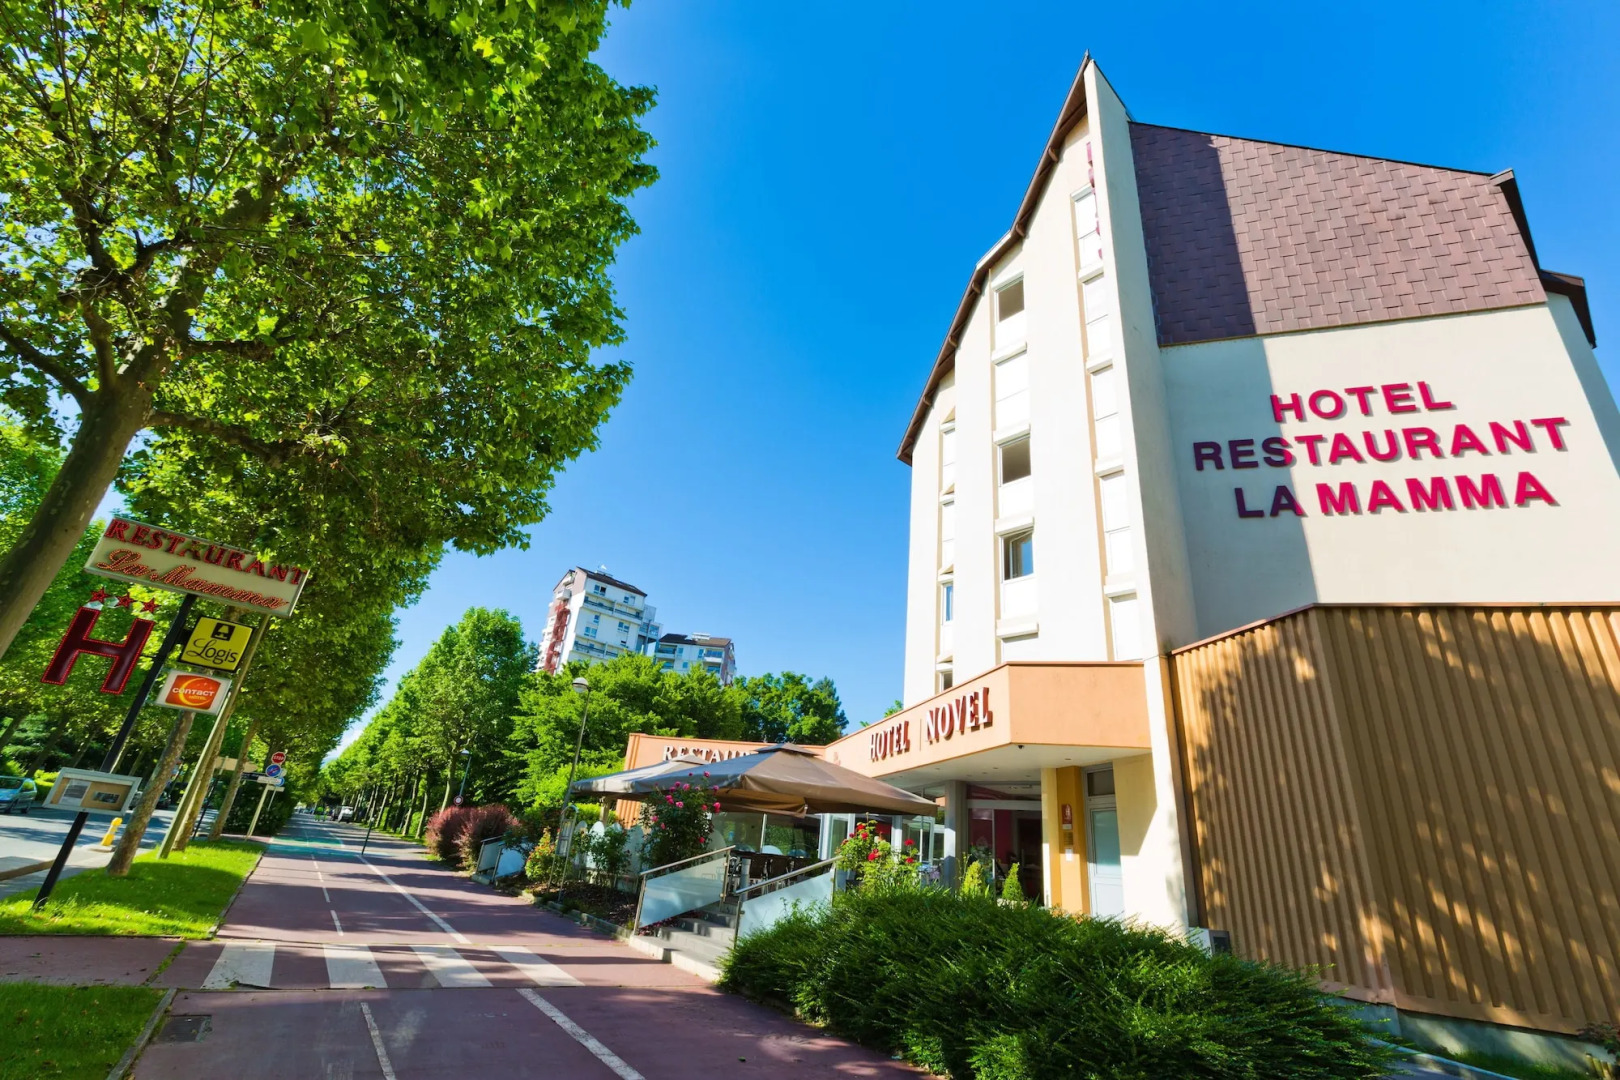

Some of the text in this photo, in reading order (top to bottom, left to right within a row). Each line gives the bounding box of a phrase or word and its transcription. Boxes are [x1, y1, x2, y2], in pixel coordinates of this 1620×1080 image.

[1270, 380, 1453, 423] HOTEL
[1192, 416, 1569, 471] RESTAURANT
[1234, 471, 1556, 518] LA MAMMA
[103, 518, 307, 585] RESTAURANT
[41, 606, 156, 694] H
[186, 637, 239, 665] Logis
[870, 686, 993, 761] HOTEL NOVEL
